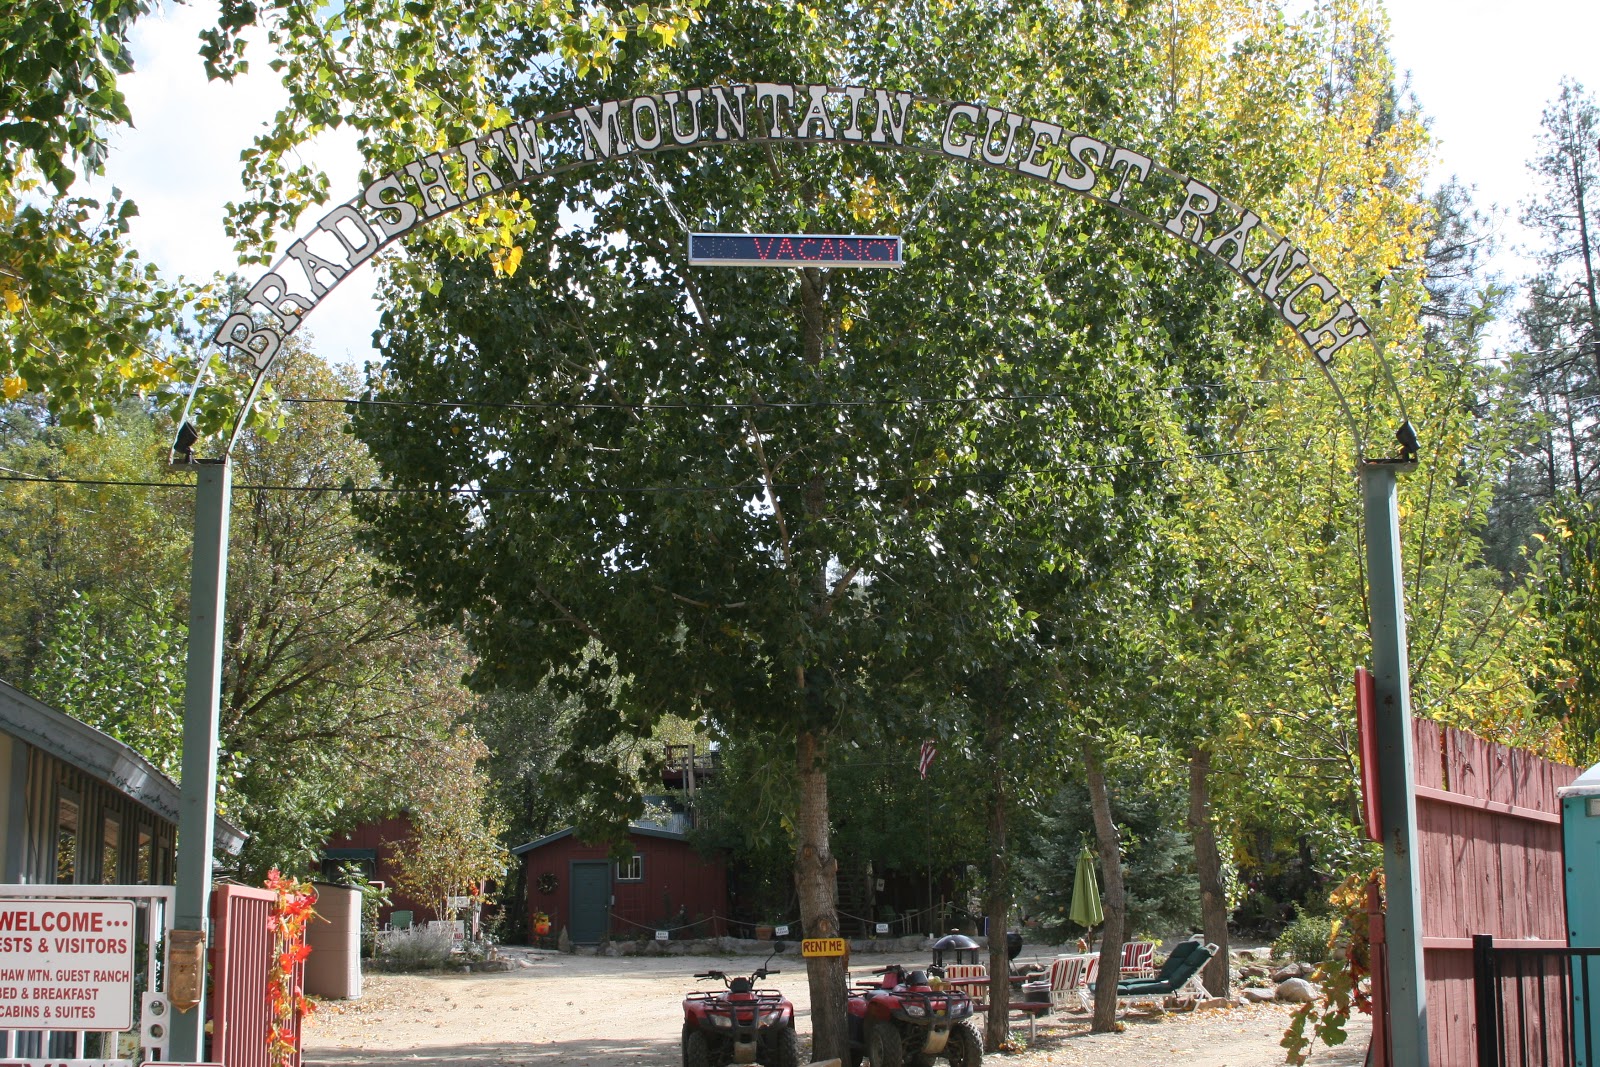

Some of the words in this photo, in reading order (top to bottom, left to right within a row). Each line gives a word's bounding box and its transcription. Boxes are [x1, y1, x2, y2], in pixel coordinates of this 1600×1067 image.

[214, 119, 544, 370] BRADSHAW
[573, 82, 912, 161] MOUNTAIN
[942, 102, 1152, 206] GUEST
[1165, 177, 1370, 364] RANCH
[752, 238, 898, 261] VACANCY
[0, 937, 32, 953] STS
[38, 938, 48, 952] &
[54, 938, 127, 954] VISITORS
[803, 940, 827, 952] RENT
[829, 940, 843, 951] ME
[27, 969, 53, 981] MTN.
[56, 970, 91, 982] GUEST
[93, 970, 130, 983] RANCH
[21, 987, 29, 1000] &
[33, 987, 99, 1000] BREAKFAST
[0, 1005, 40, 1018] CABINS
[43, 1006, 51, 1018] &
[55, 1006, 96, 1019] SUITES
